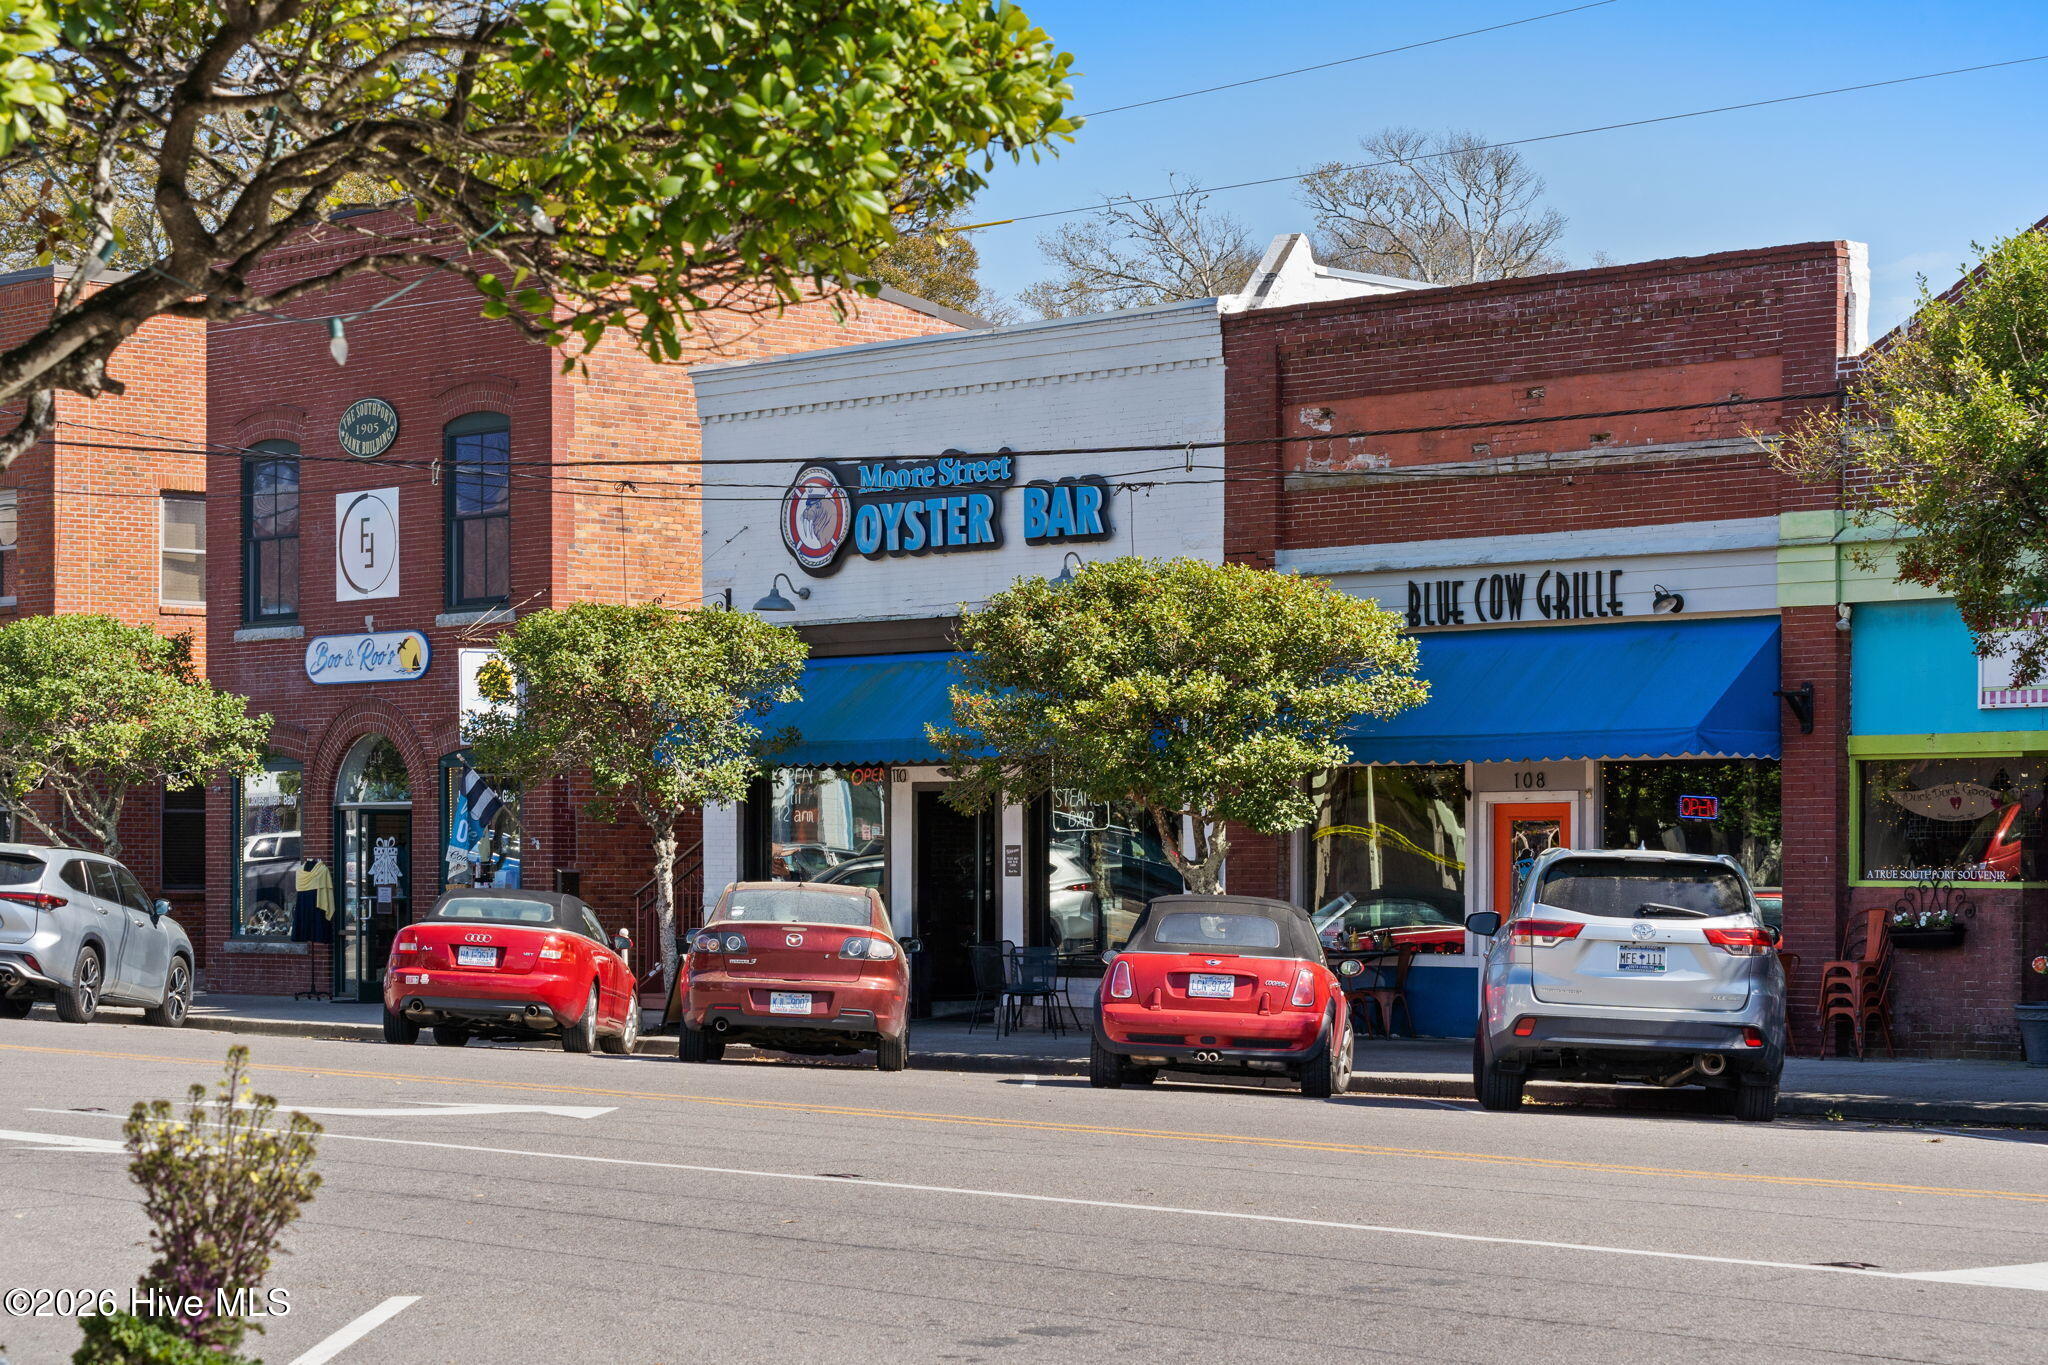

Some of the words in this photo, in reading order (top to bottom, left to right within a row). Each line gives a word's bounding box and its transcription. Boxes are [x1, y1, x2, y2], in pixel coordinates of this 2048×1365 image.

[343, 409, 356, 430] THE
[355, 402, 393, 425] SOUTHPORT
[356, 422, 379, 435] 1905
[343, 432, 361, 453] BANK
[361, 428, 392, 455] BUILDING
[858, 463, 935, 494] Moore
[938, 455, 1012, 486] Street
[854, 493, 995, 554] OYSTER
[1023, 485, 1104, 539] BAR
[1405, 580, 1464, 627] BLUE
[1474, 572, 1526, 622] COW
[1536, 569, 1624, 619] GRILLE
[310, 641, 343, 676] Boo
[345, 649, 353, 667] &
[357, 637, 396, 671] Roo's
[892, 769, 907, 783] 110
[1514, 772, 1545, 789] 108
[283, 793, 298, 809] Baby
[1902, 791, 1932, 802] Duck
[1932, 785, 1961, 799] Duck
[794, 809, 814, 823] am
[1682, 798, 1715, 817] OPEN
[1867, 870, 1874, 879] A
[1875, 869, 1898, 879] TRUE
[1900, 869, 1956, 880] SOUTHPORT
[1957, 869, 2006, 880] SOUVENIR
[1620, 952, 1637, 964] MFE
[1646, 953, 1663, 965] 111
[1191, 980, 1232, 993] LCN-9732
